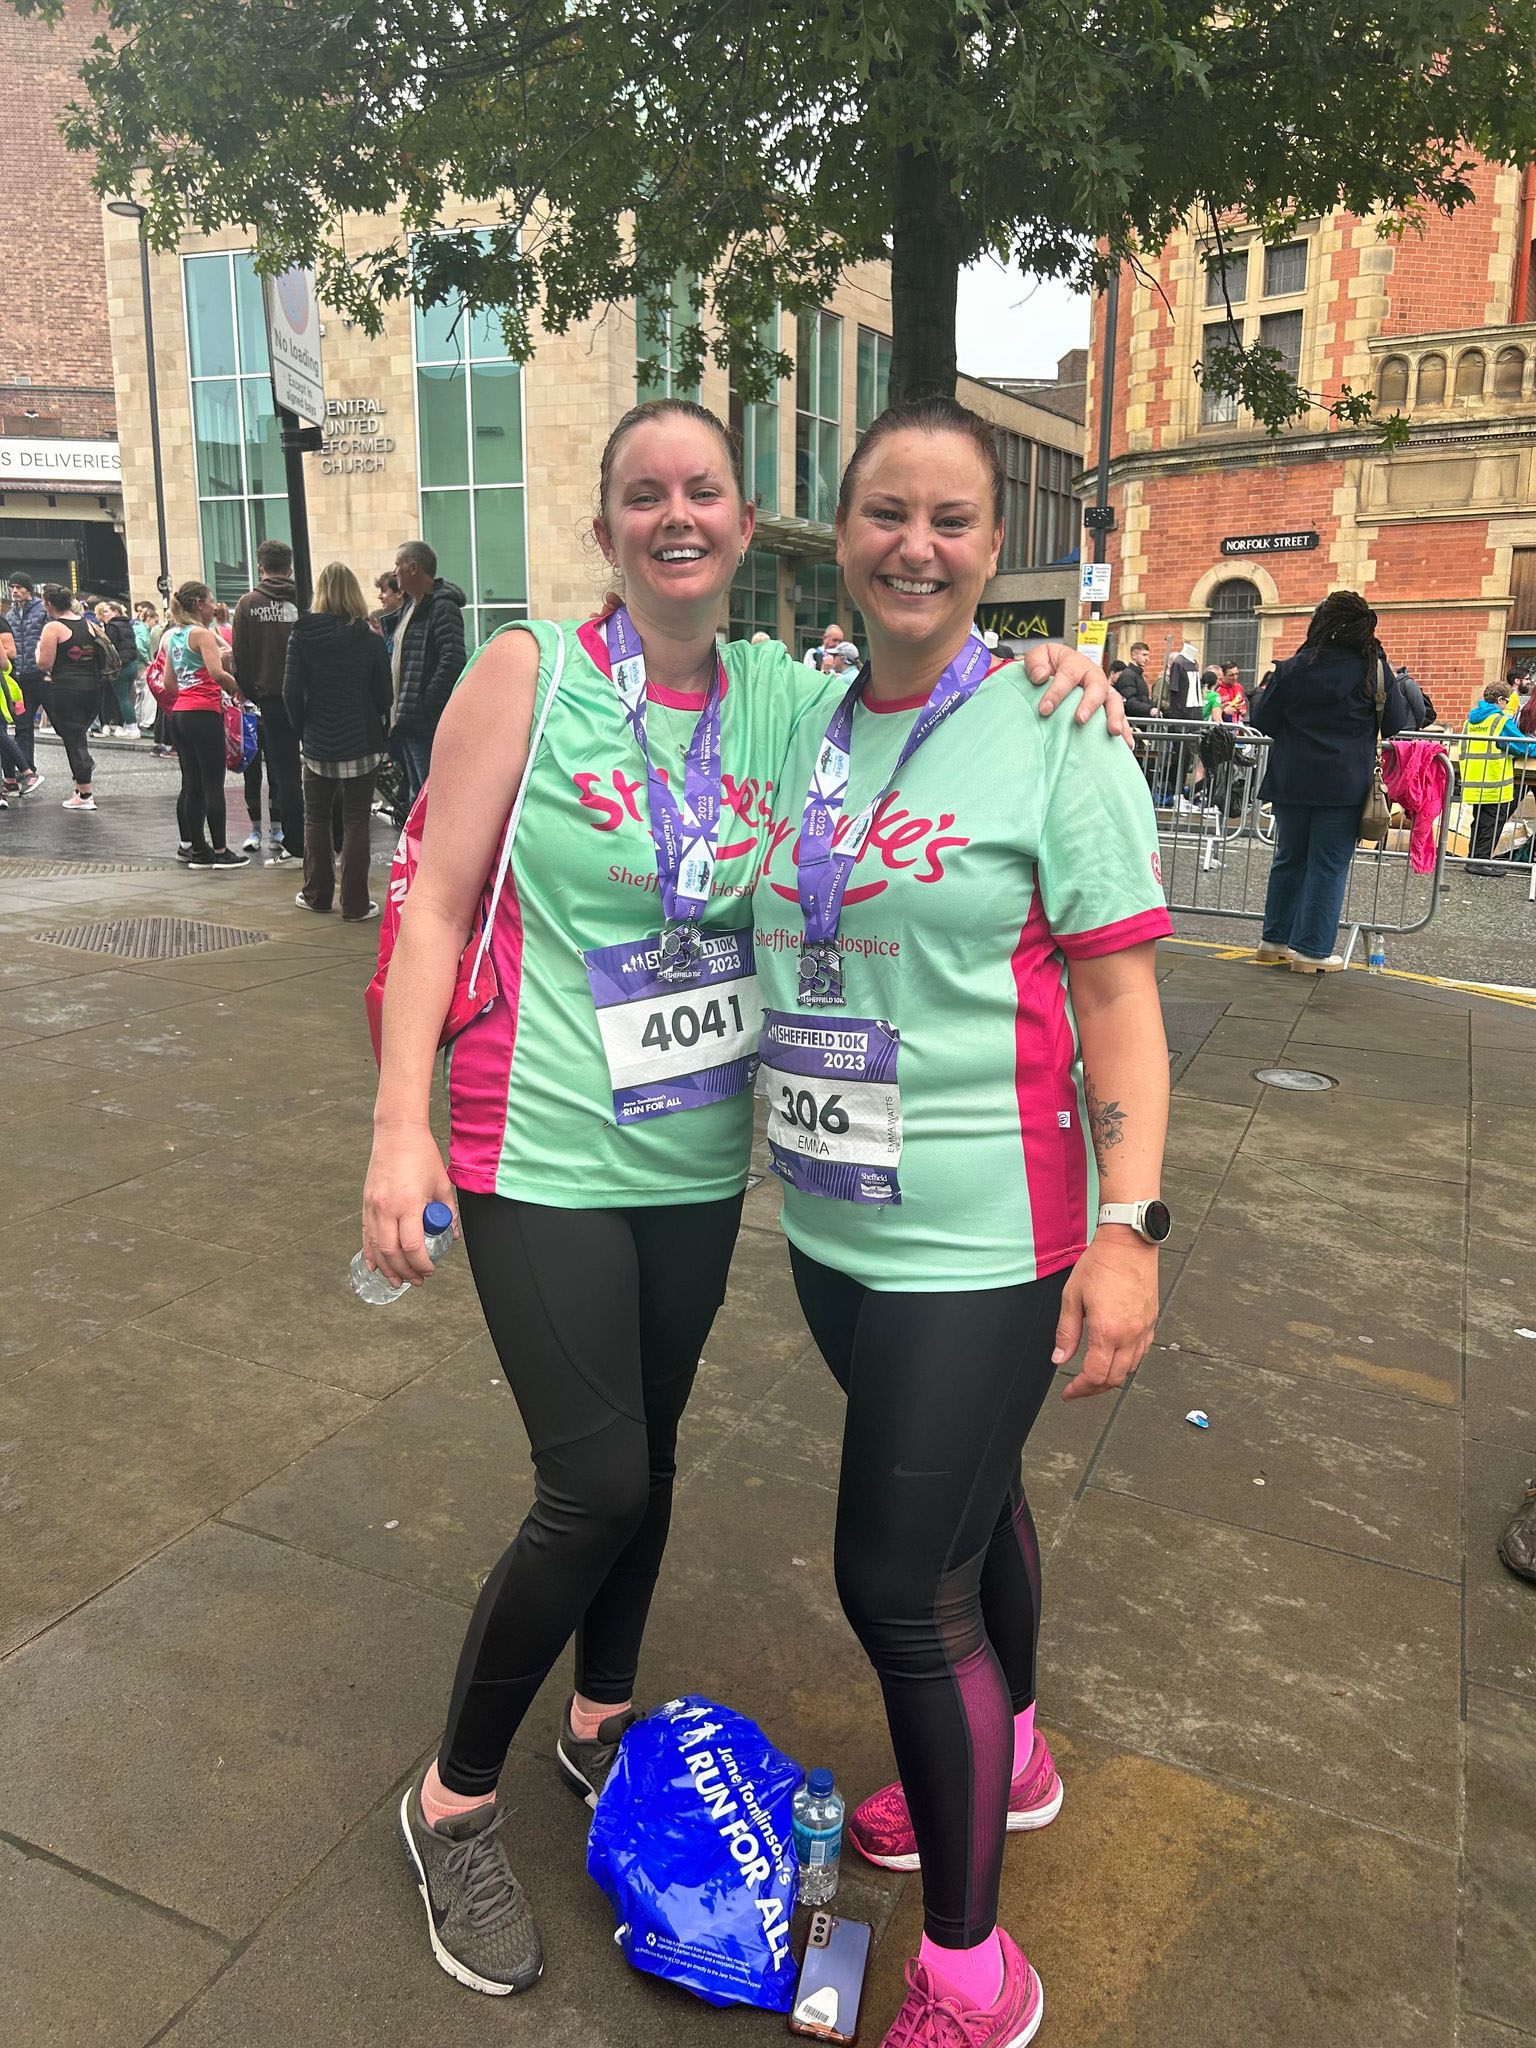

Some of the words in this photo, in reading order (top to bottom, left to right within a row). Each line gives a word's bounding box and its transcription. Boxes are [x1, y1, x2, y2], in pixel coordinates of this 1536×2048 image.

[274, 327, 288, 352] No
[290, 338, 320, 378] loading
[325, 399, 387, 417] ENTRAL
[324, 418, 380, 436] UNITED
[315, 438, 397, 457] EFORMED
[20, 452, 121, 470] DELIVERIES
[320, 457, 387, 475] CHURCH
[1226, 538, 1271, 551] NORFOLK
[1273, 535, 1310, 548] STREET
[250, 606, 283, 617] NORTH
[260, 614, 284, 622] MATE
[951, 690, 961, 702] ALL
[572, 769, 644, 832] St
[696, 795, 707, 819] 2023
[808, 809, 816, 835] FINISHER
[815, 809, 827, 837] 2023
[662, 824, 671, 840] RUN
[665, 840, 673, 855] FOR
[827, 873, 842, 910] SHEFFIELD
[838, 861, 846, 875] 10K
[688, 904, 696, 917] 10K
[715, 937, 737, 953] 10K
[709, 955, 741, 974] 2023
[641, 994, 744, 1052] 4041
[779, 1027, 835, 1048] SHEFFIELD
[837, 1034, 865, 1050] 10K
[823, 1052, 866, 1071] 2023
[623, 1104, 645, 1116] RUN
[645, 1100, 664, 1111] FOR
[665, 1096, 681, 1107] ALL
[781, 1086, 850, 1134] 306
[885, 1096, 895, 1129] WATTS
[887, 1129, 895, 1153] EMMA
[861, 1173, 888, 1182] Sheffield
[717, 1747, 742, 1784] Jane
[738, 1780, 792, 1886] Tomlinson's
[685, 1750, 740, 1821] RUN
[719, 1819, 771, 1889] FOR
[754, 1897, 794, 1972] ALL
